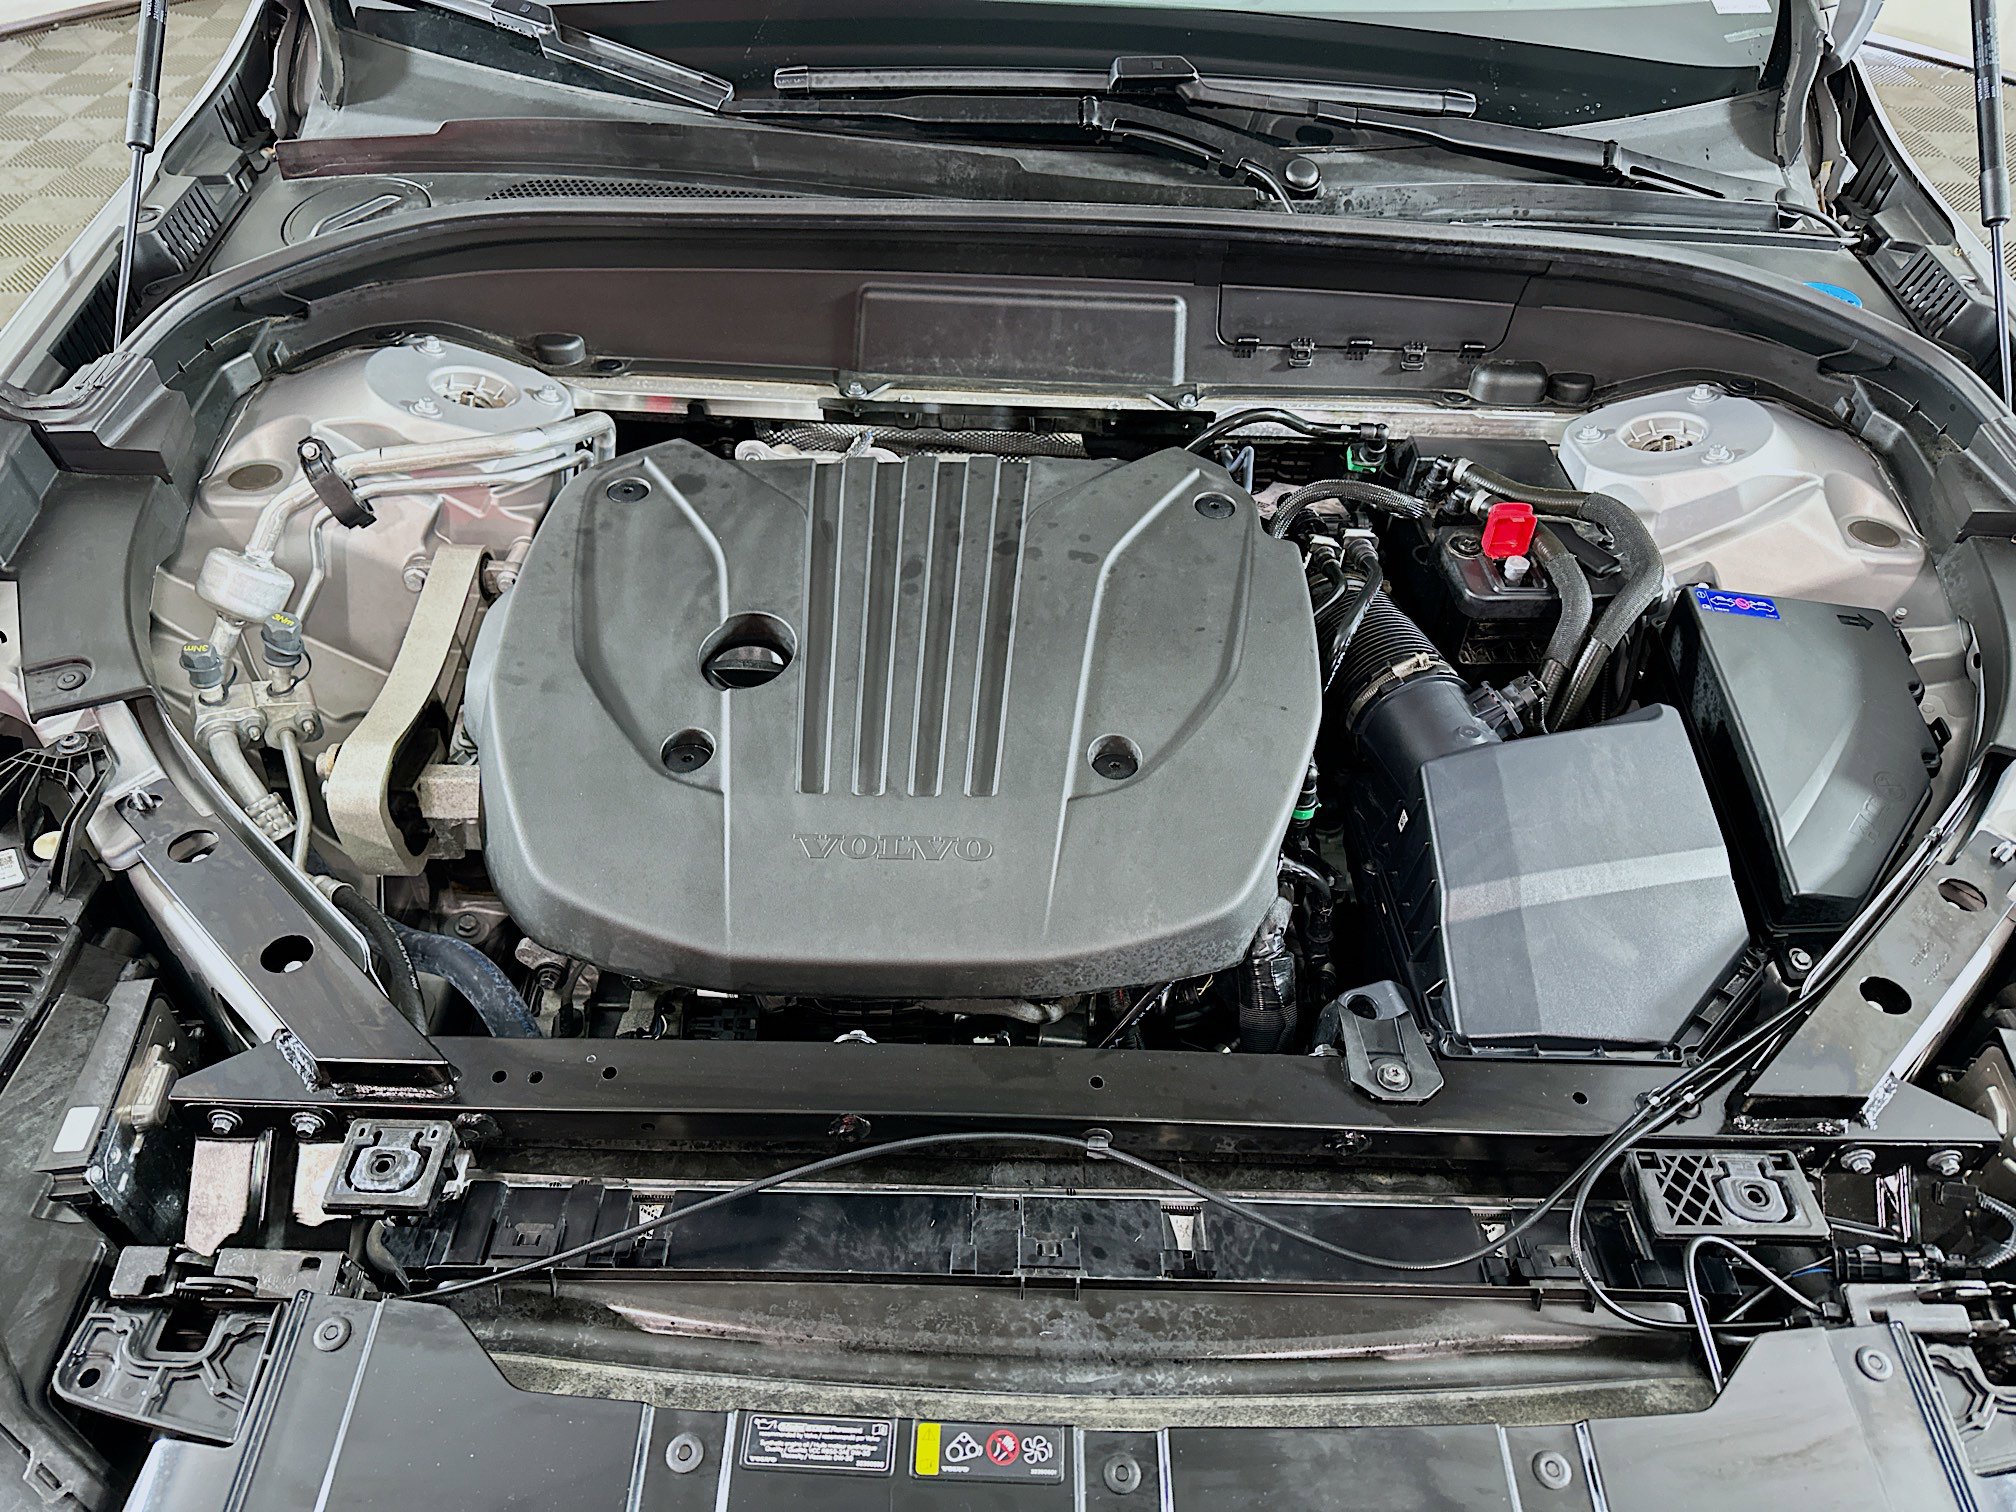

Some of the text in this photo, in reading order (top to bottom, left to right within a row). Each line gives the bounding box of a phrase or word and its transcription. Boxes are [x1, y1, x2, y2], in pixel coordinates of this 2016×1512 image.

[272, 613, 295, 627] 3Nm
[183, 644, 209, 652] 3Nm
[792, 833, 993, 862] VOLVO
[941, 1465, 970, 1473] VOLVO
